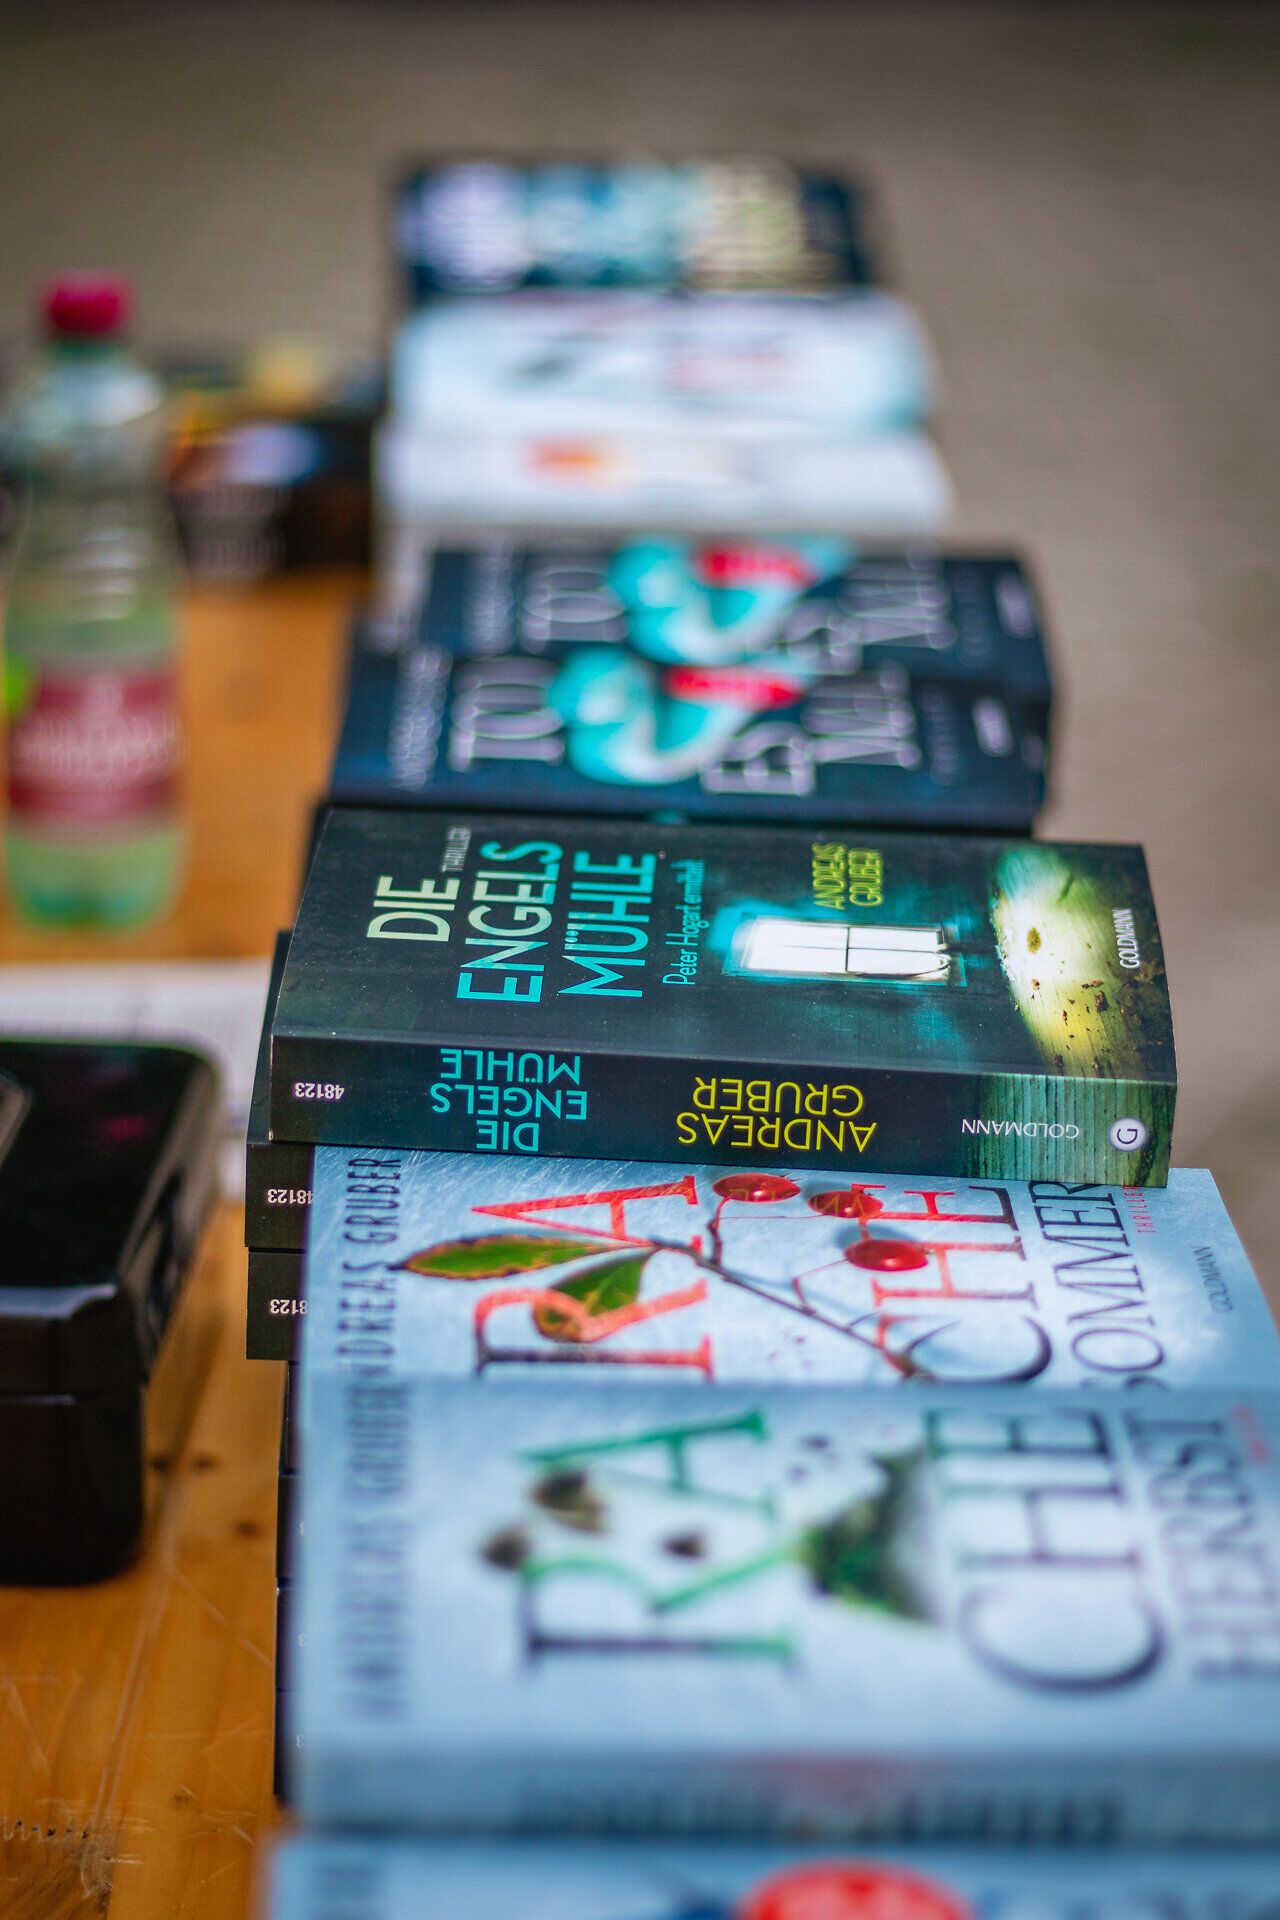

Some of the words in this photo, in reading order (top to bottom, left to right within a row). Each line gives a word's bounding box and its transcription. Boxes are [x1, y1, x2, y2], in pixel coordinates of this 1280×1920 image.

[367, 875, 461, 943] DIE
[455, 840, 564, 1003] ENGELS
[556, 850, 657, 998] MÜHLE
[1111, 906, 1142, 970] GOLDMANN
[662, 949, 699, 986] Peter
[440, 1048, 582, 1086] MÜHLE
[294, 1081, 346, 1101] 48123
[429, 1083, 588, 1121] ENGELS
[692, 1076, 864, 1118] GRUBER
[476, 1120, 539, 1153] DIE
[676, 1111, 878, 1154] ANDREAS
[961, 1118, 1080, 1141] GOLDMANN
[344, 1158, 402, 1244] GRUBER
[1027, 1180, 1171, 1391] OMMER
[1192, 1245, 1233, 1315] GOLDMANN
[269, 1299, 310, 1316] 8123
